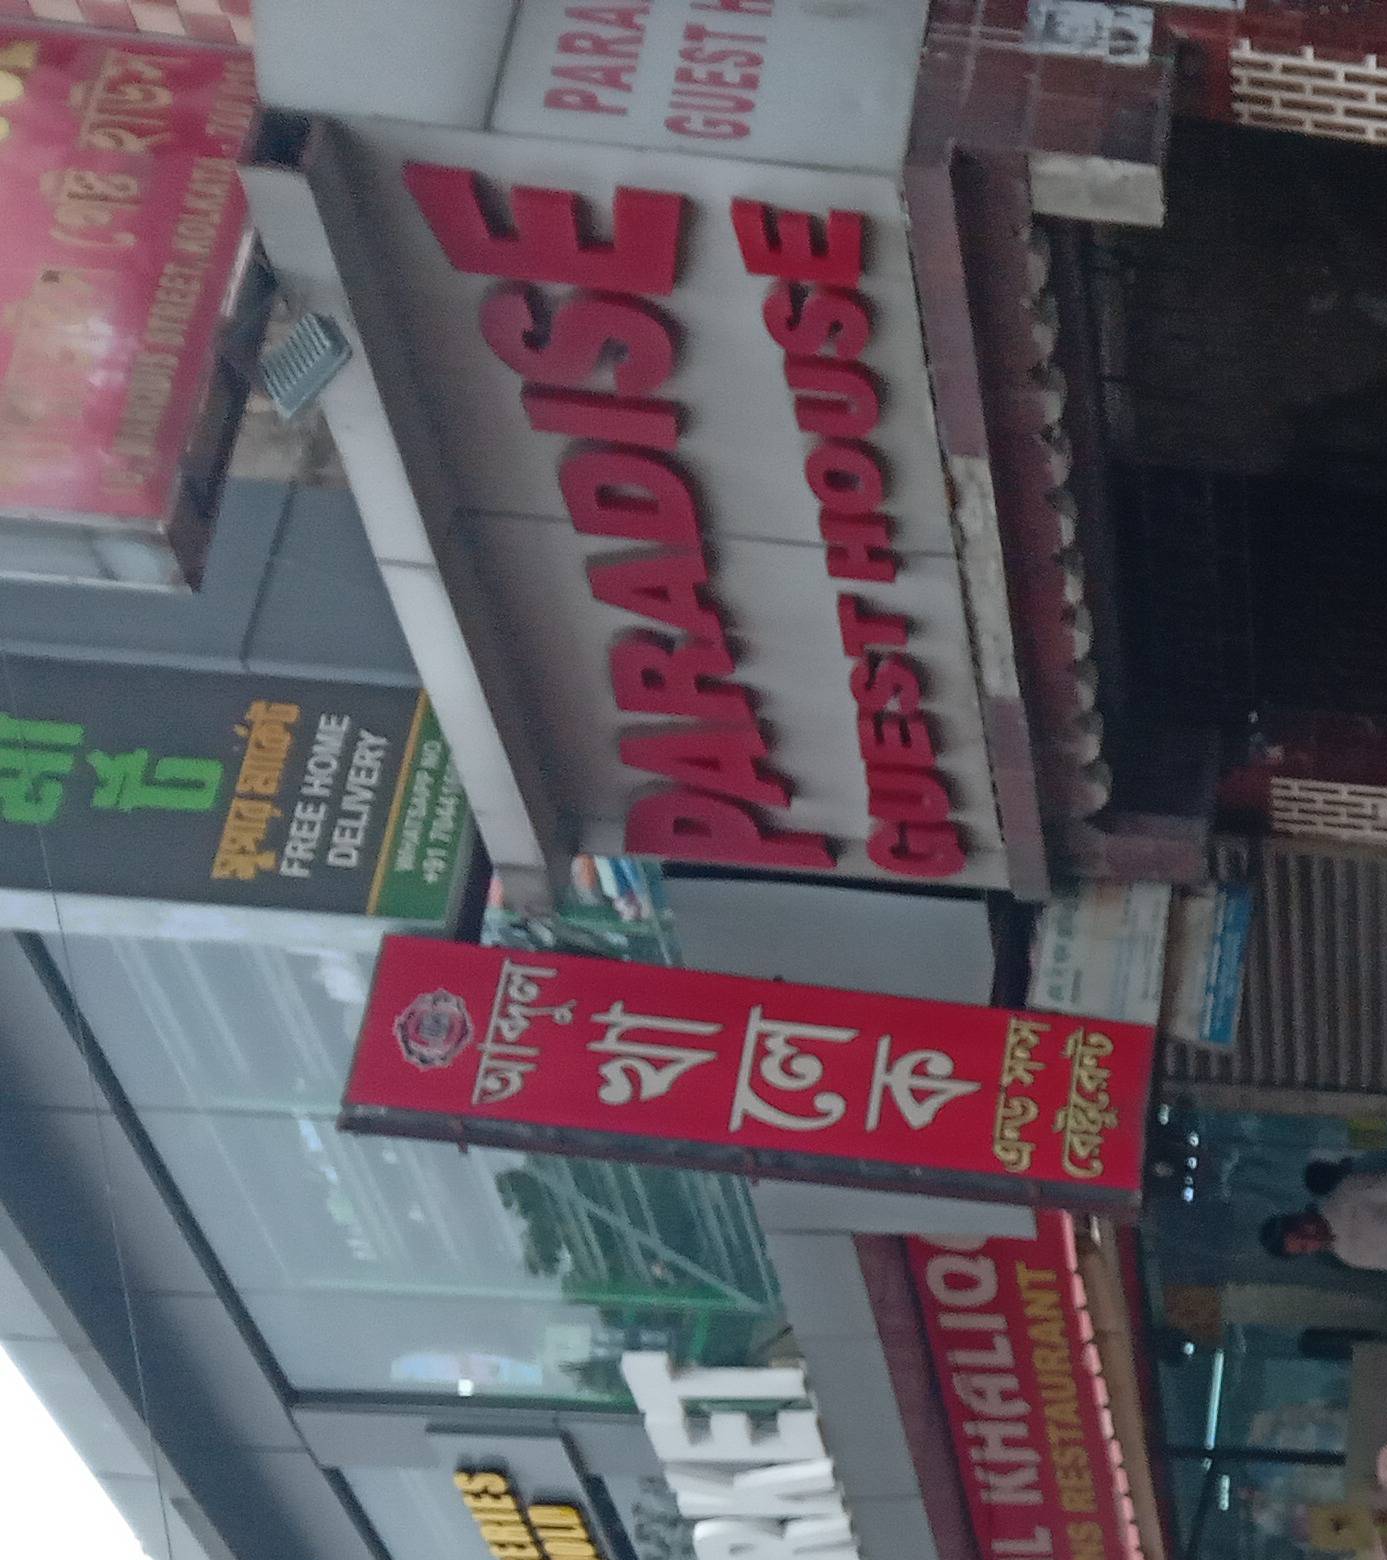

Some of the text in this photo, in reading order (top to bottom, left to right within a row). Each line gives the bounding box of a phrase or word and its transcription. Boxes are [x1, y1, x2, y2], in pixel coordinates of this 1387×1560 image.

[663, 23, 768, 141] GUEST
[402, 161, 838, 868] PARADISE
[730, 199, 966, 876] GUEST HOUSE
[279, 713, 350, 878] FREE HOME
[326, 728, 388, 868] DELIVERY
[1016, 1260, 1097, 1513] RESTAURANT
